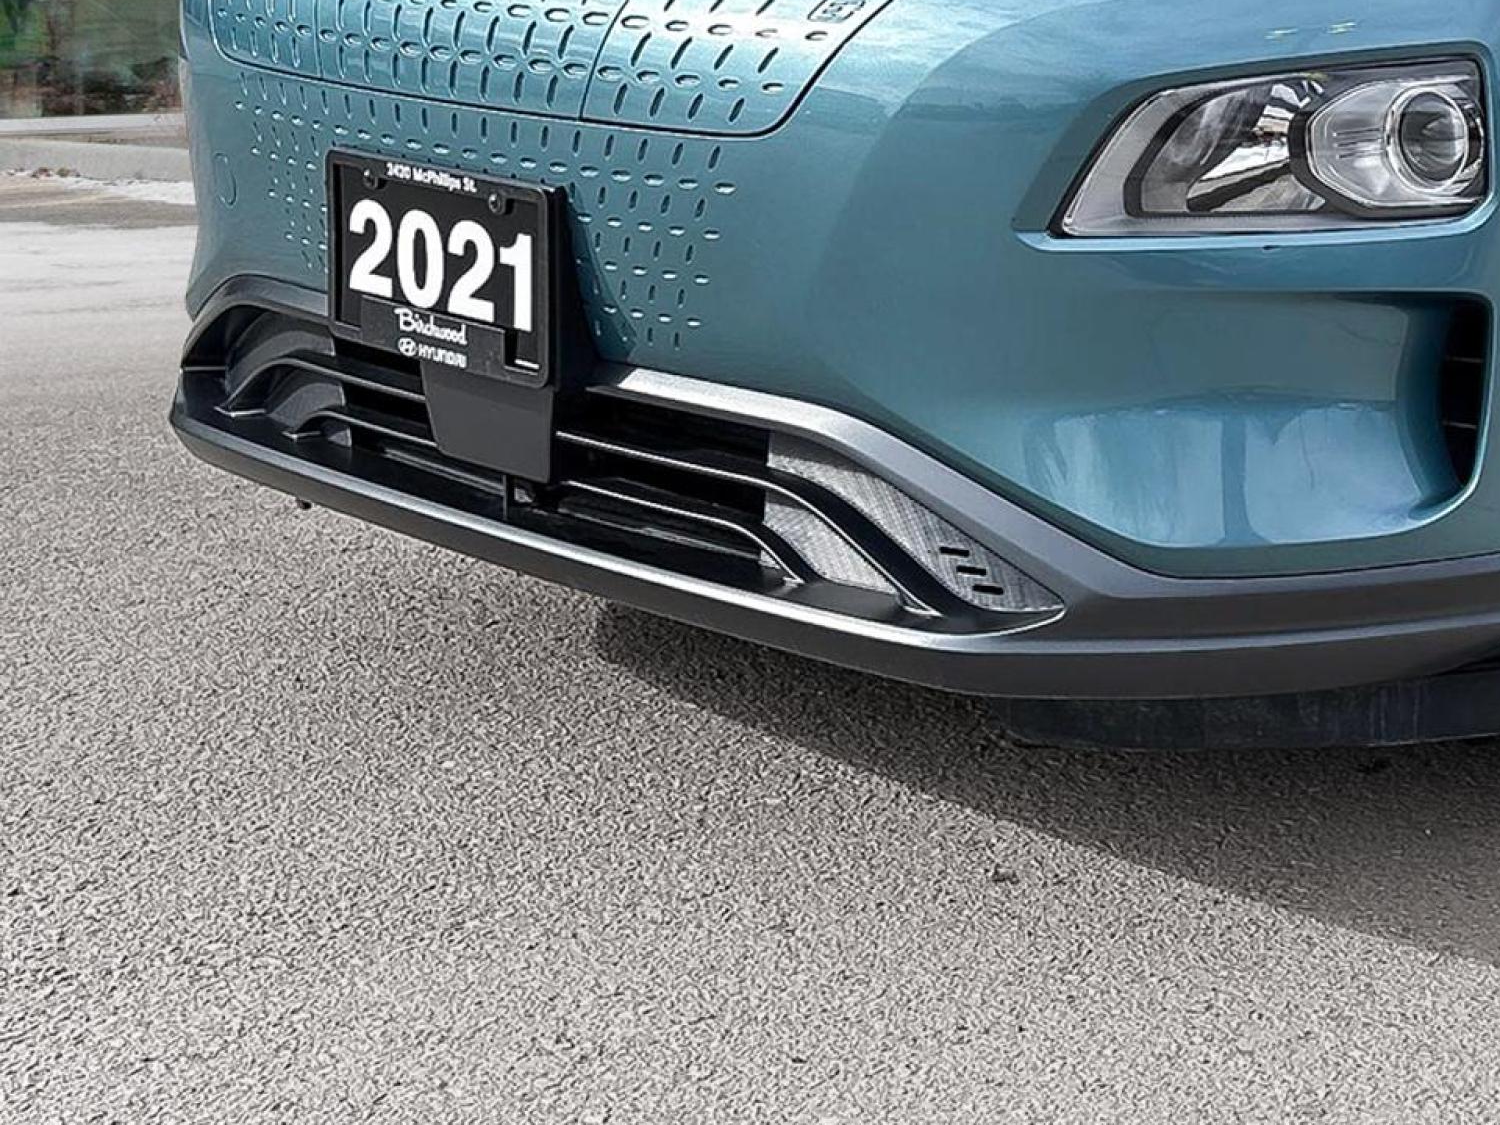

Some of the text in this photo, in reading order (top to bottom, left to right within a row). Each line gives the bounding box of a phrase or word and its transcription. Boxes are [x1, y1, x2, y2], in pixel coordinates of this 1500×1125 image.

[349, 198, 533, 333] 2021
[393, 307, 468, 346] Birchwood
[418, 342, 468, 369] HYUNDAI
